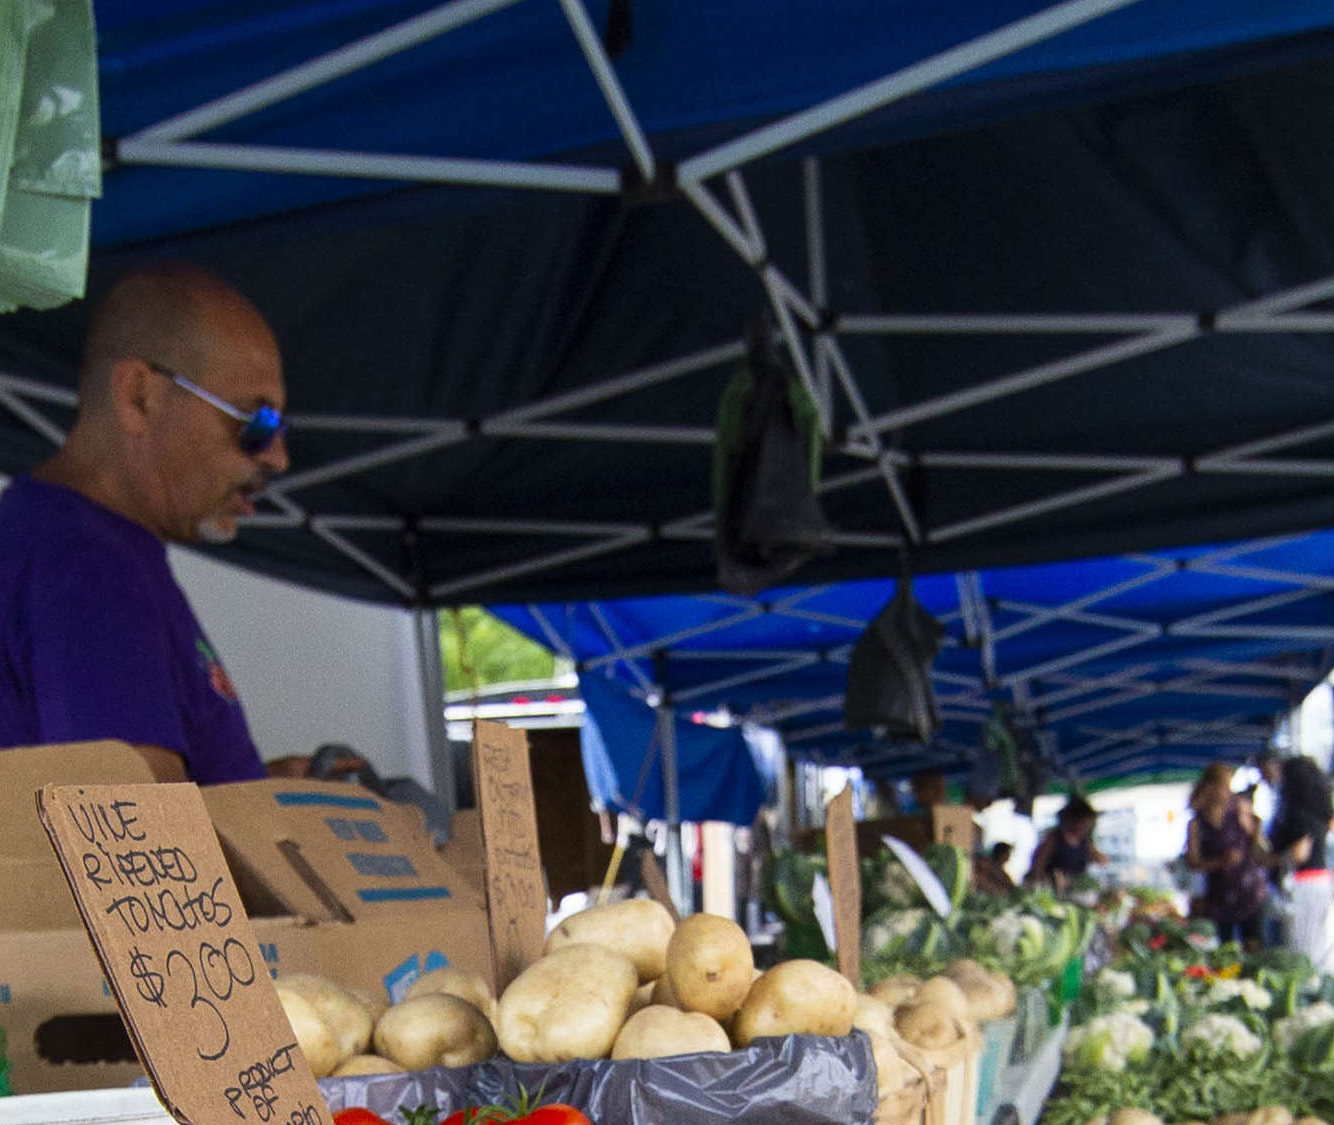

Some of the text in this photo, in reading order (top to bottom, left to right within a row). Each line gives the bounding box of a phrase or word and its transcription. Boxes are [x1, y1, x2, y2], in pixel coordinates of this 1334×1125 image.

[68, 791, 146, 843] VINE
[83, 842, 197, 891] RIPENED
[253, 1084, 279, 1122] OF
